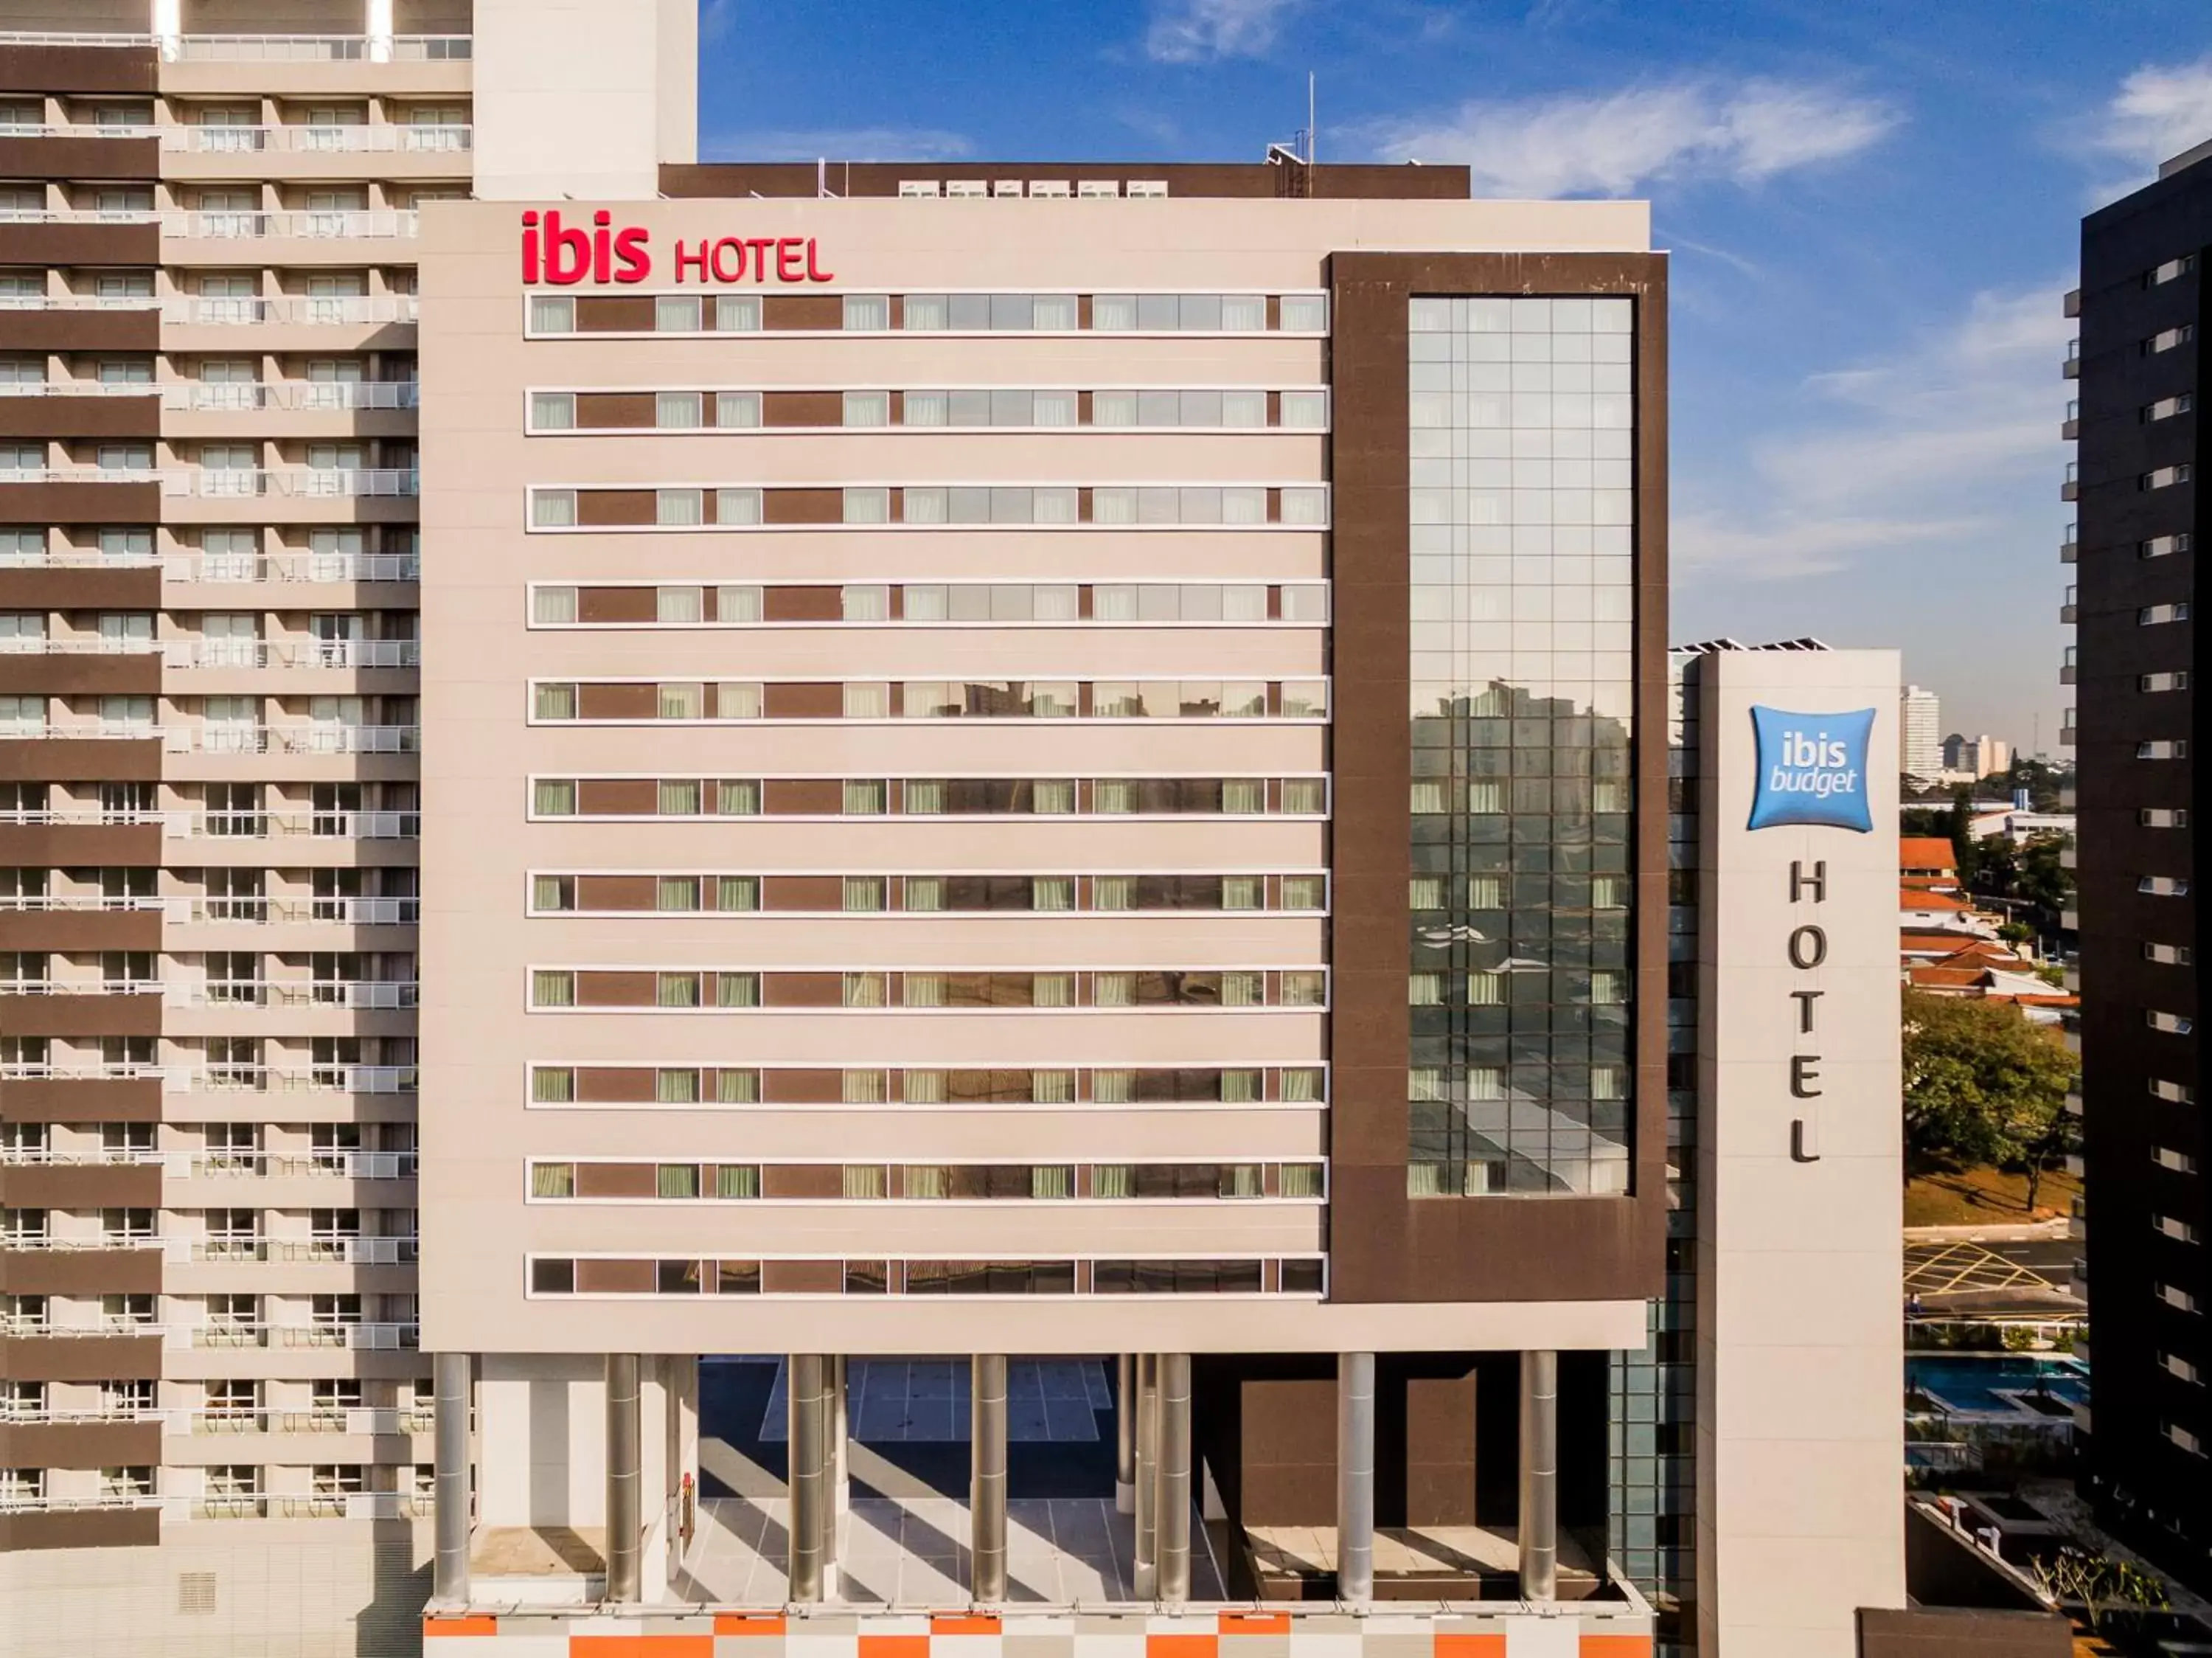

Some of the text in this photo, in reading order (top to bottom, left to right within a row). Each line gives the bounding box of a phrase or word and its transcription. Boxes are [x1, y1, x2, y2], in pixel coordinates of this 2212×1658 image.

[522, 210, 834, 285] ibis HOTEL
[1783, 731, 1847, 769] ibis
[1770, 766, 1857, 799] budget
[1788, 860, 1827, 1162] HOTEL
